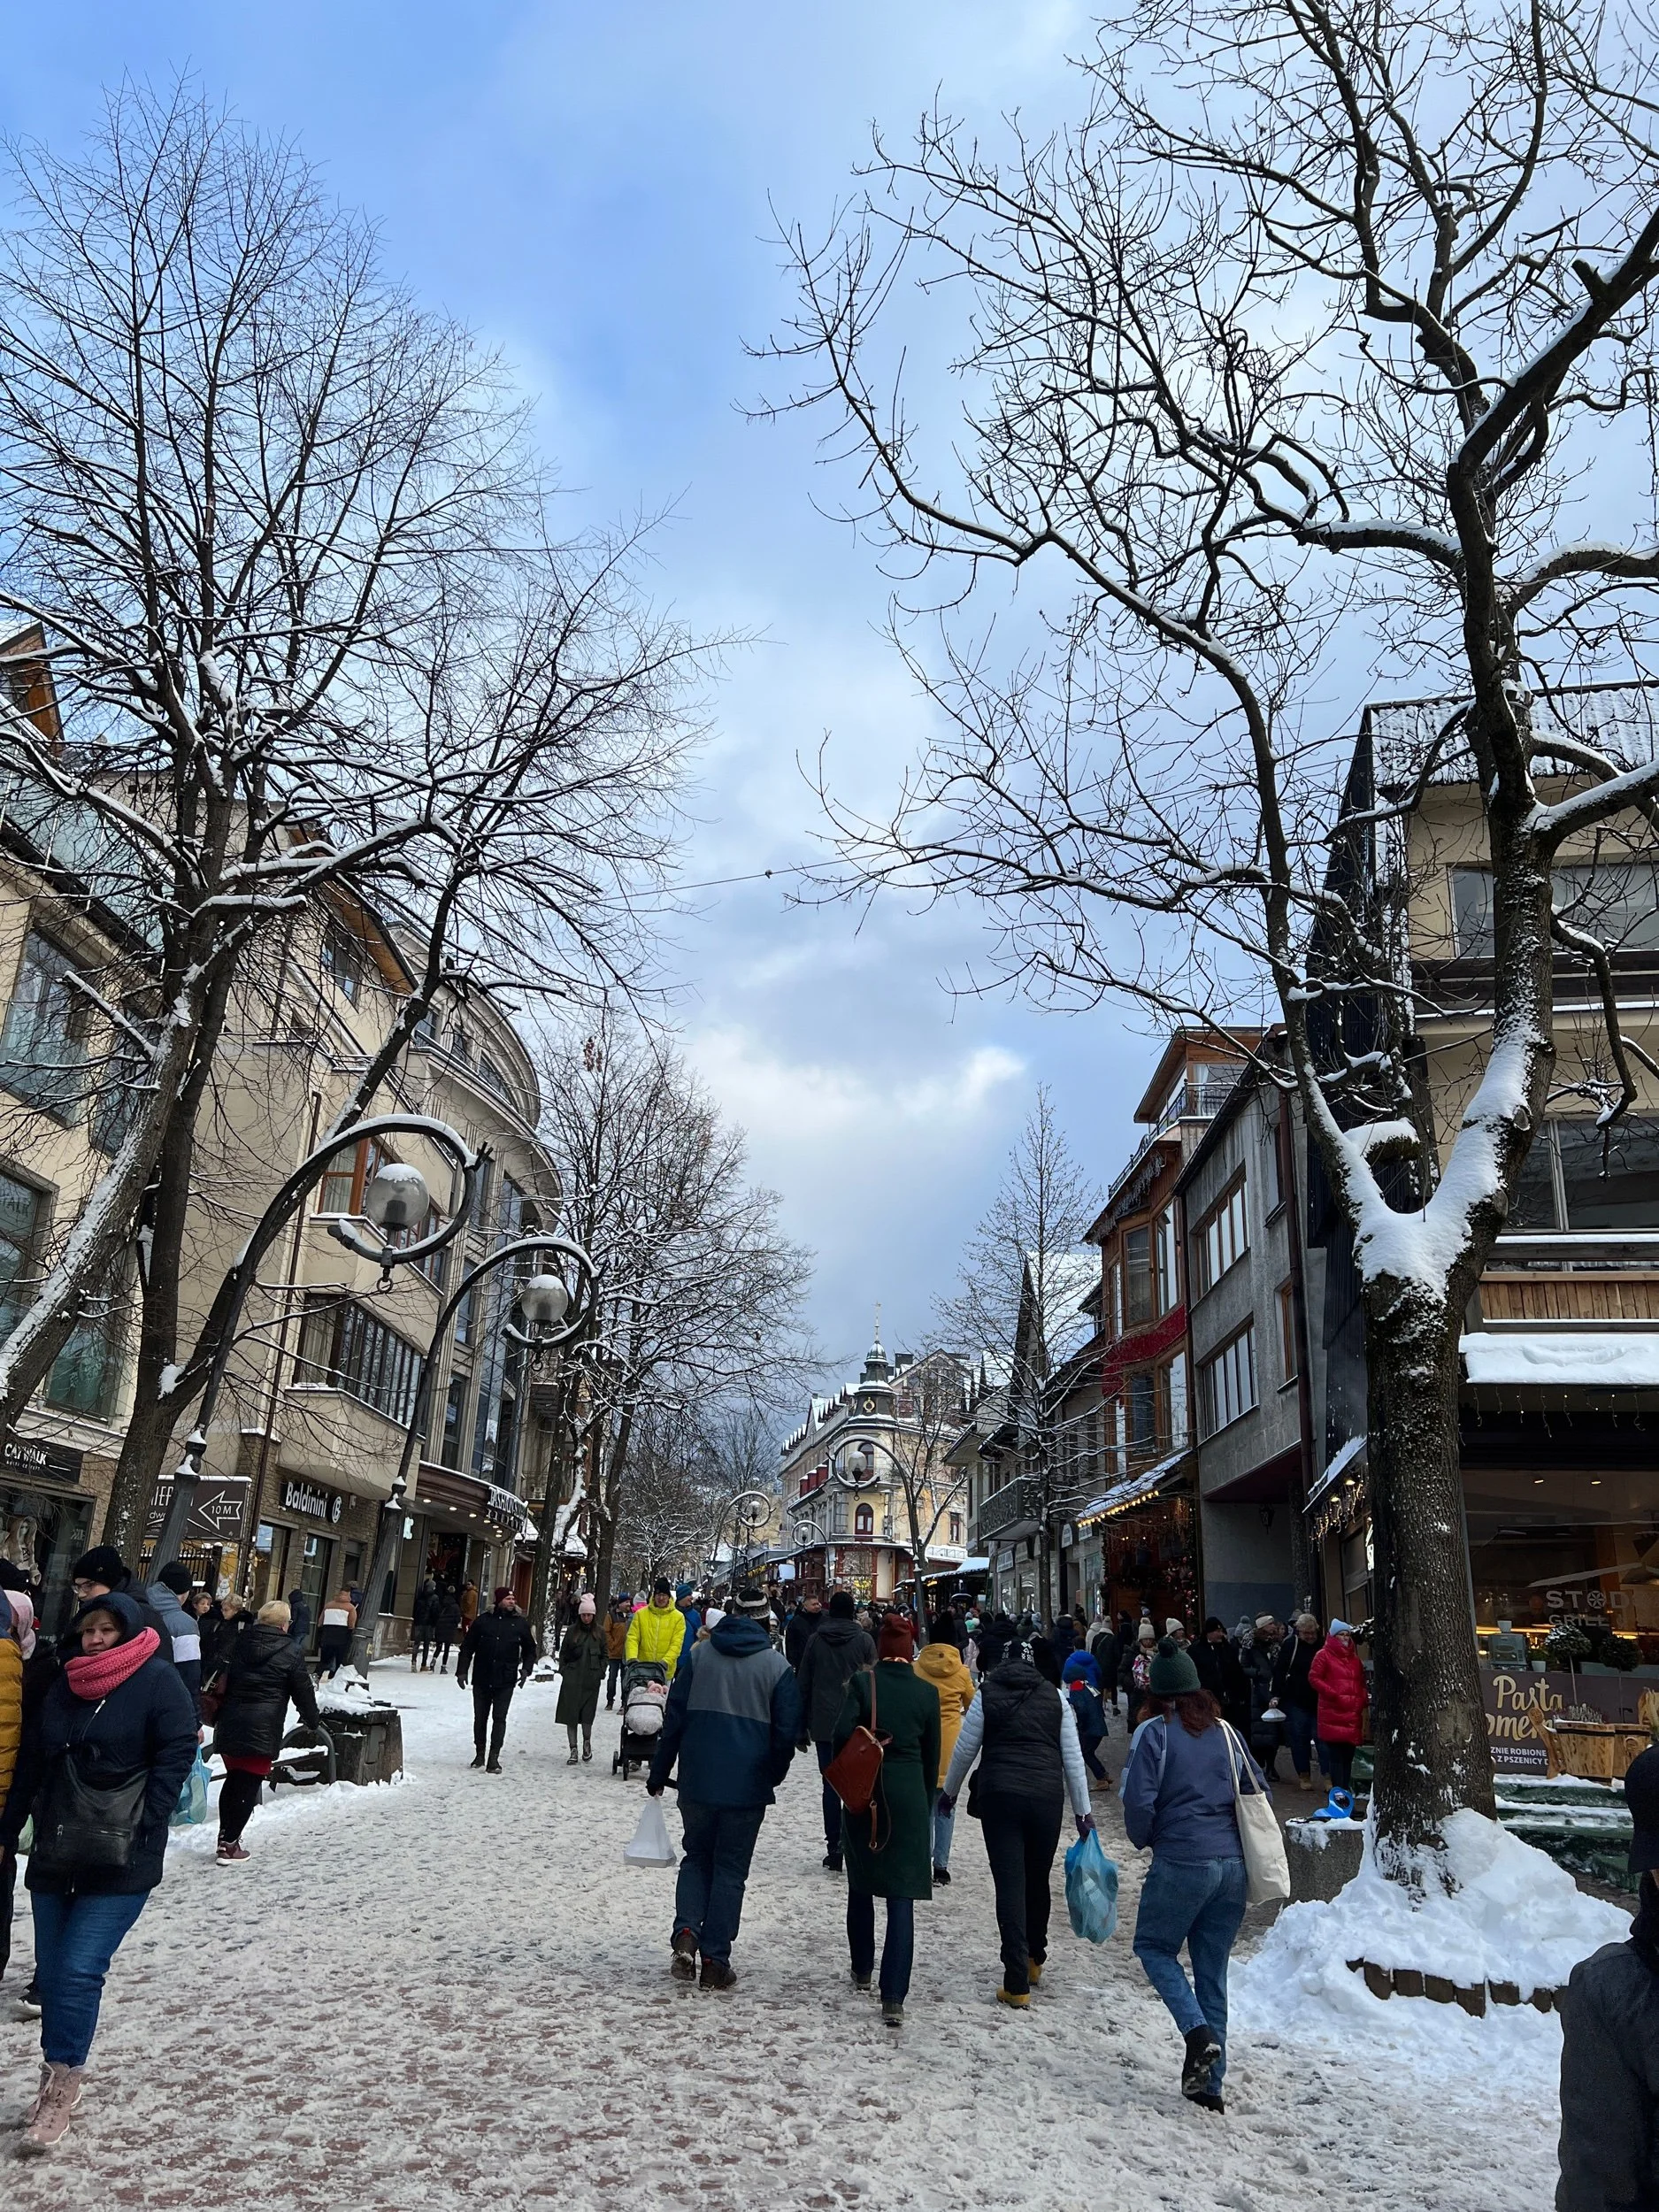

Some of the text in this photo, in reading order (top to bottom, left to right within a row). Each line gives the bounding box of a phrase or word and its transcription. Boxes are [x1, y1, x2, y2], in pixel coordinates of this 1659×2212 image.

[285, 1481, 328, 1517] Baldinini
[1493, 1675, 1563, 1712] Pasta
[1504, 1756, 1543, 1765] PSZENICY
[1509, 1747, 1548, 1757] ROBIONE
